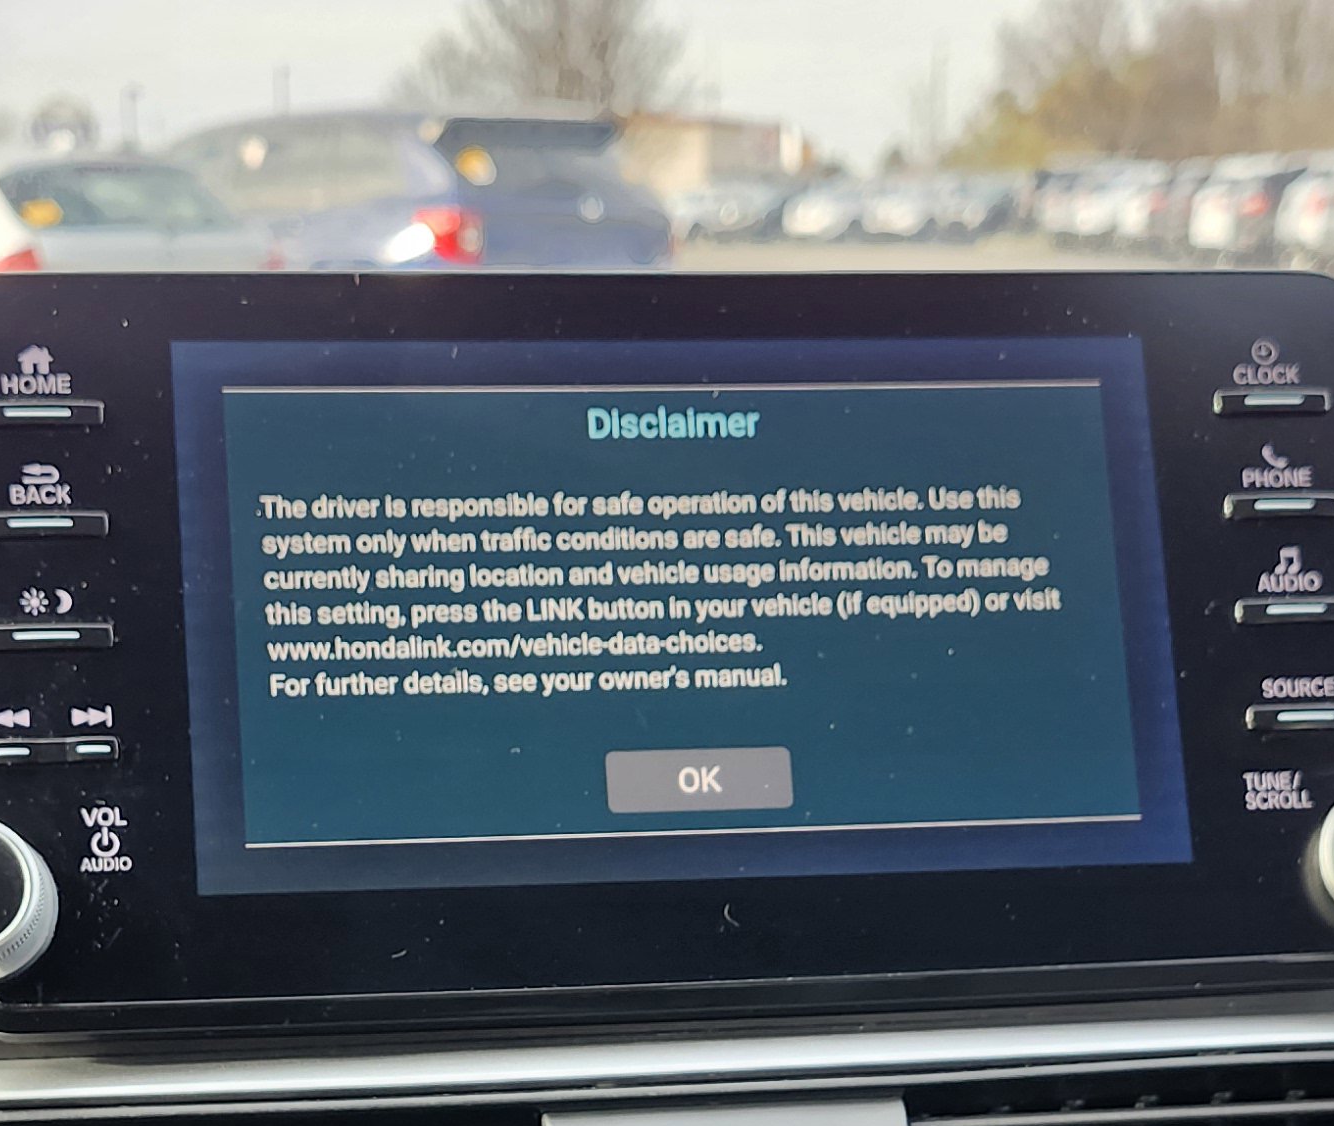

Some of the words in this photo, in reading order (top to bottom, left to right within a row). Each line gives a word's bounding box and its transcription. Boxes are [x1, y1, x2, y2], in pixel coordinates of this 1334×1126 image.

[0, 373, 71, 395] HOME
[1233, 364, 1300, 385] CLOCK
[587, 404, 761, 440] Disclaimer
[1242, 465, 1313, 488] PHONE
[9, 483, 72, 505] BACK
[259, 494, 307, 519] The
[311, 494, 380, 518] driver
[385, 494, 407, 518] is
[411, 492, 549, 523] responsible
[553, 491, 588, 516] for
[592, 490, 644, 516] safe
[647, 491, 757, 521] operation
[761, 487, 787, 513] of
[788, 488, 834, 513] this
[838, 486, 925, 512] vehicle.
[928, 486, 974, 511] Use
[976, 484, 1021, 510] this
[262, 531, 351, 560] system
[355, 528, 407, 558] only
[410, 528, 476, 553] when
[480, 526, 552, 552] traffic
[555, 526, 678, 551] conditions
[683, 529, 721, 549] are
[724, 523, 782, 548] safe.
[785, 523, 837, 547] This
[840, 521, 921, 546] vehicle
[925, 523, 975, 549] may
[978, 519, 1009, 544] be
[263, 565, 370, 594] currently
[375, 564, 465, 593] sharing
[469, 563, 564, 587] location
[568, 561, 614, 586] and
[617, 559, 700, 585] vehicle
[703, 562, 776, 588] usage
[779, 556, 918, 582] information.
[921, 555, 954, 579] To
[956, 556, 1050, 582] manage
[1257, 571, 1323, 593] AUDIO
[265, 601, 311, 625] this
[317, 601, 406, 629] setting,
[410, 602, 478, 629] press
[482, 598, 522, 623] the
[526, 597, 585, 622] LINK
[587, 596, 664, 621] button
[669, 596, 691, 620] in
[694, 599, 747, 624] your
[751, 592, 833, 617] vehicle
[837, 590, 863, 620] (if
[866, 587, 981, 619] equipped)
[985, 592, 1010, 612] or
[1013, 587, 1061, 611] visit
[267, 630, 763, 661] www.hondalink.com/vehicle-data-choices.
[269, 673, 311, 697] For
[315, 671, 399, 696] further
[403, 669, 489, 696] details,
[493, 673, 537, 693] see
[541, 671, 594, 697] your
[599, 664, 690, 690] owner's
[694, 662, 787, 688] manual.
[678, 766, 722, 793] OK
[1242, 770, 1303, 791] TUNE/
[1245, 790, 1314, 810] SCROLL
[80, 806, 128, 827] VOL
[80, 856, 132, 872] AUDIO
